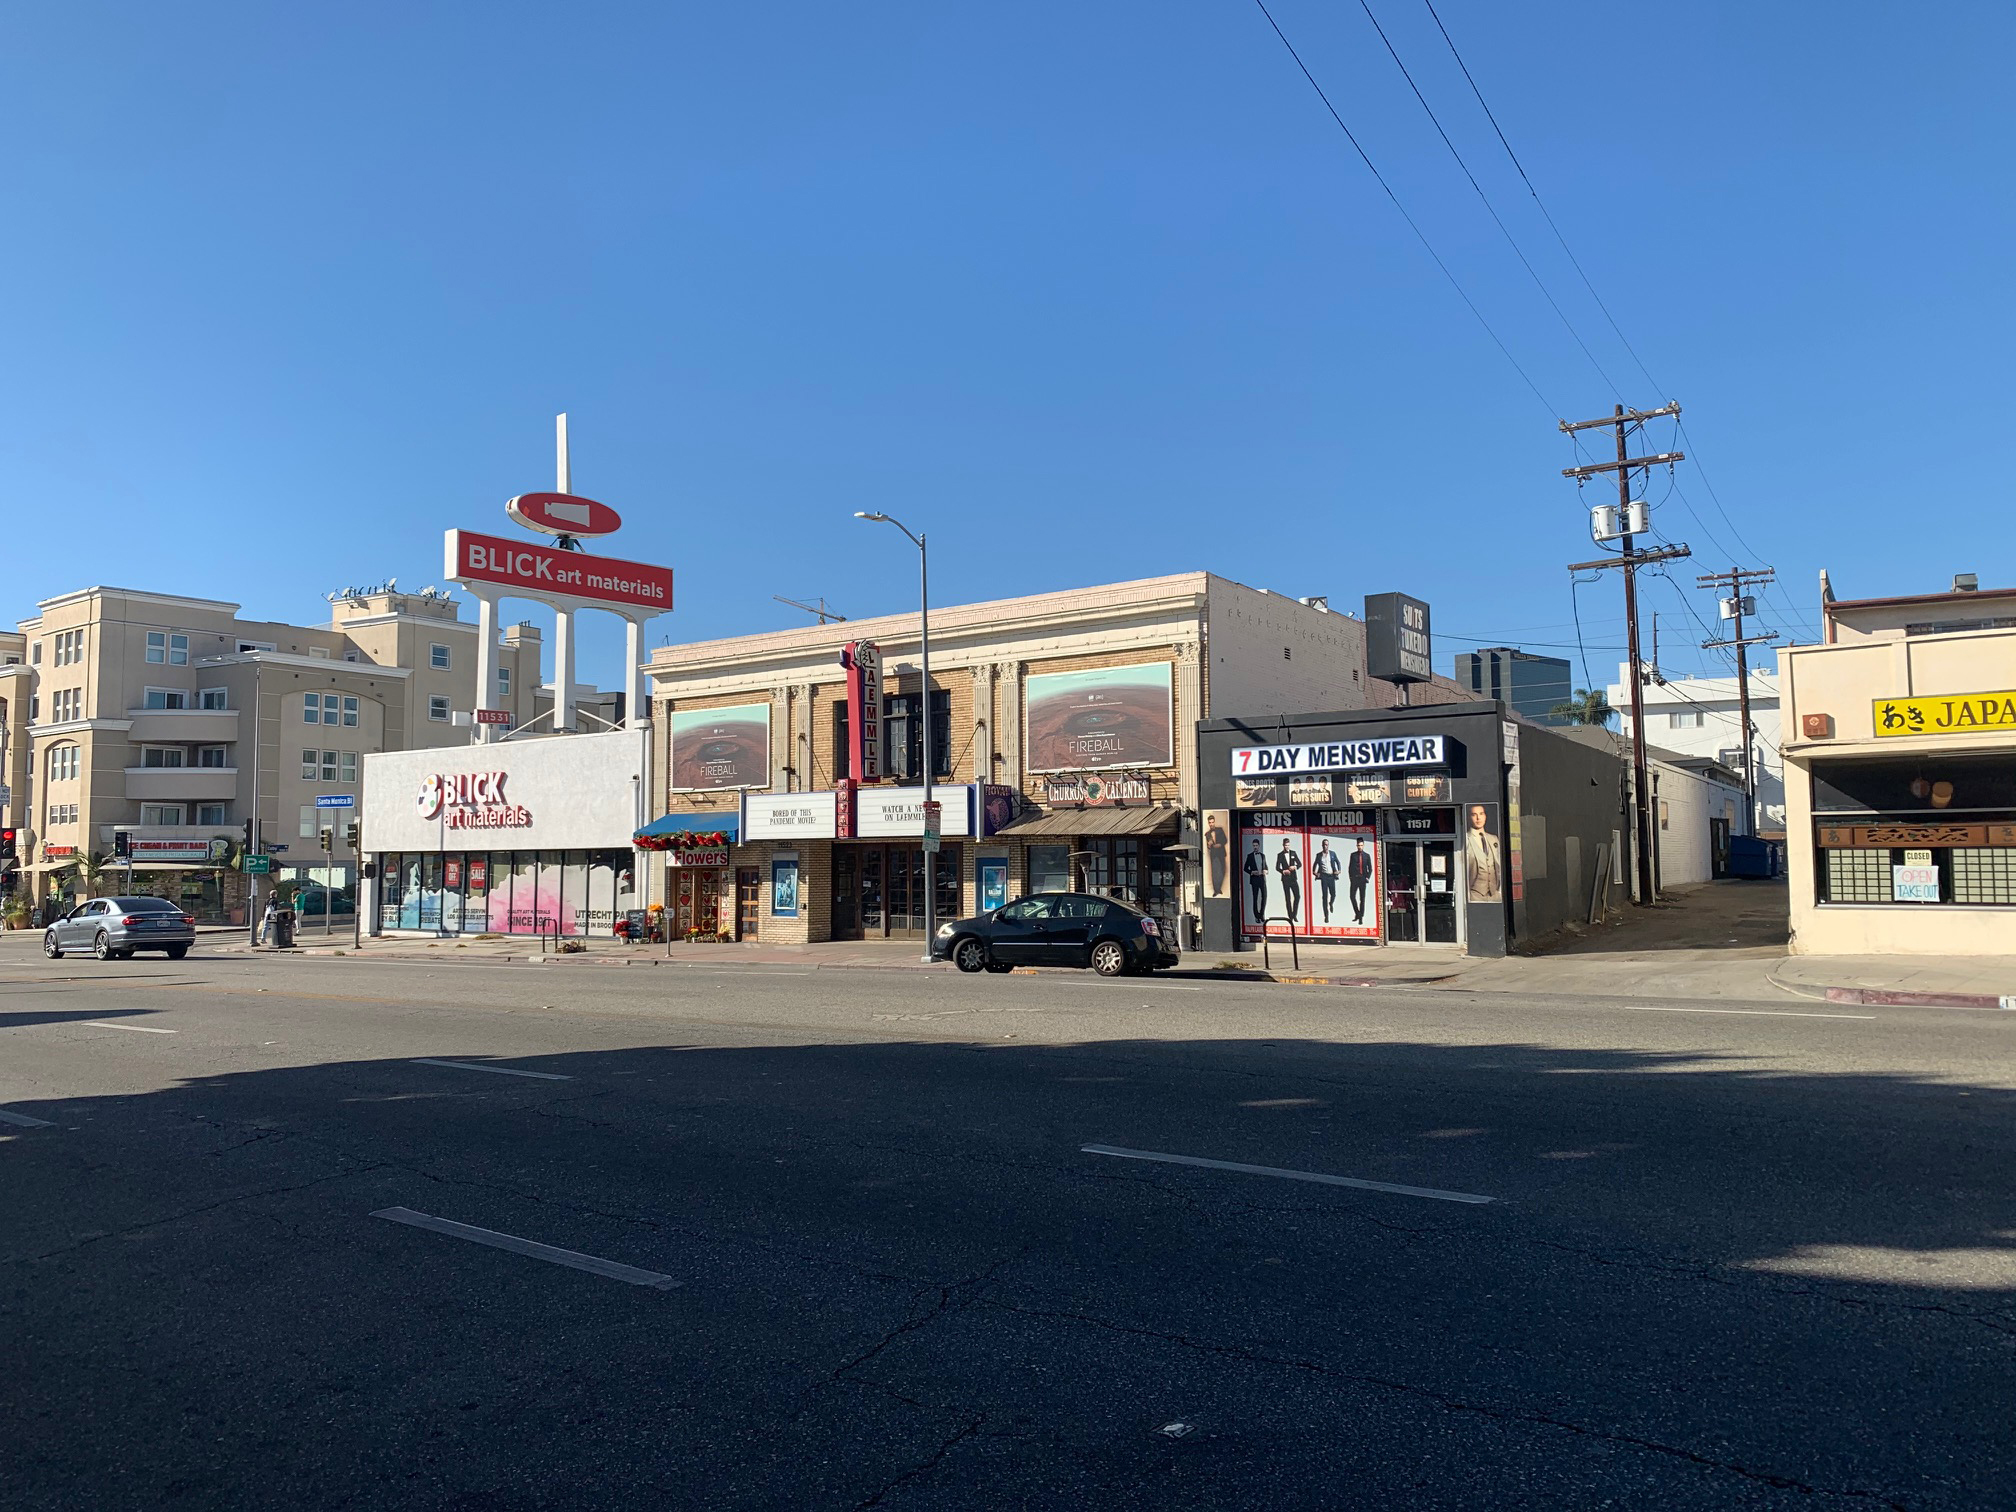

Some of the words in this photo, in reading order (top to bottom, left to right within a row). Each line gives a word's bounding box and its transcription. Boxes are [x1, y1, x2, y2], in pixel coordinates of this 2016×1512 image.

[468, 543, 554, 581] BLICK
[556, 567, 582, 585] art
[587, 573, 664, 599] materials
[1403, 603, 1423, 630] SUITS
[1400, 626, 1428, 656] TUXEDO
[1400, 649, 1430, 677] MENSWEAR
[479, 712, 509, 722] 11531
[866, 650, 877, 775] LAEMMLE
[1881, 702, 1926, 732] あき
[1936, 698, 2016, 728] JAPA
[1069, 738, 1124, 754] FIREBALL
[1239, 750, 1252, 773] 7
[1258, 747, 1301, 771] DAY
[1308, 738, 1437, 768] MENSWEAR
[700, 764, 738, 777] FIREBALL
[1351, 774, 1384, 786] TAILOR
[1406, 775, 1436, 785] CUSTOM
[443, 771, 505, 805] BLICK
[1049, 783, 1084, 802] CHURROS
[1105, 780, 1147, 800] CALIENTES
[1407, 787, 1437, 797] CLOTHES
[1292, 793, 1309, 802] BOYS
[1310, 792, 1330, 802] SUITS
[1355, 789, 1381, 801] SHOP
[772, 809, 790, 817] BORED
[790, 809, 798, 817] OF
[799, 808, 812, 816] THIS
[882, 804, 904, 814] WATCH
[907, 804, 911, 812] A
[443, 807, 463, 827] art
[464, 804, 529, 828] materials
[769, 817, 795, 826] PANDEMIC
[797, 816, 817, 825] MOVIE?
[884, 814, 894, 822] ON
[1253, 811, 1293, 827] SUITS
[1319, 810, 1364, 826] TUXEDO
[1406, 819, 1432, 829] 11517
[674, 850, 727, 865] Flowers
[1906, 852, 1930, 861] CLOSED
[448, 872, 456, 881] OFF
[471, 869, 485, 880] SALE
[1901, 870, 1932, 883] OPEN
[1896, 884, 1922, 899] TAKE
[1923, 884, 1938, 898] OUT
[507, 916, 532, 926] SINCE
[575, 910, 612, 920] UTRECHT
